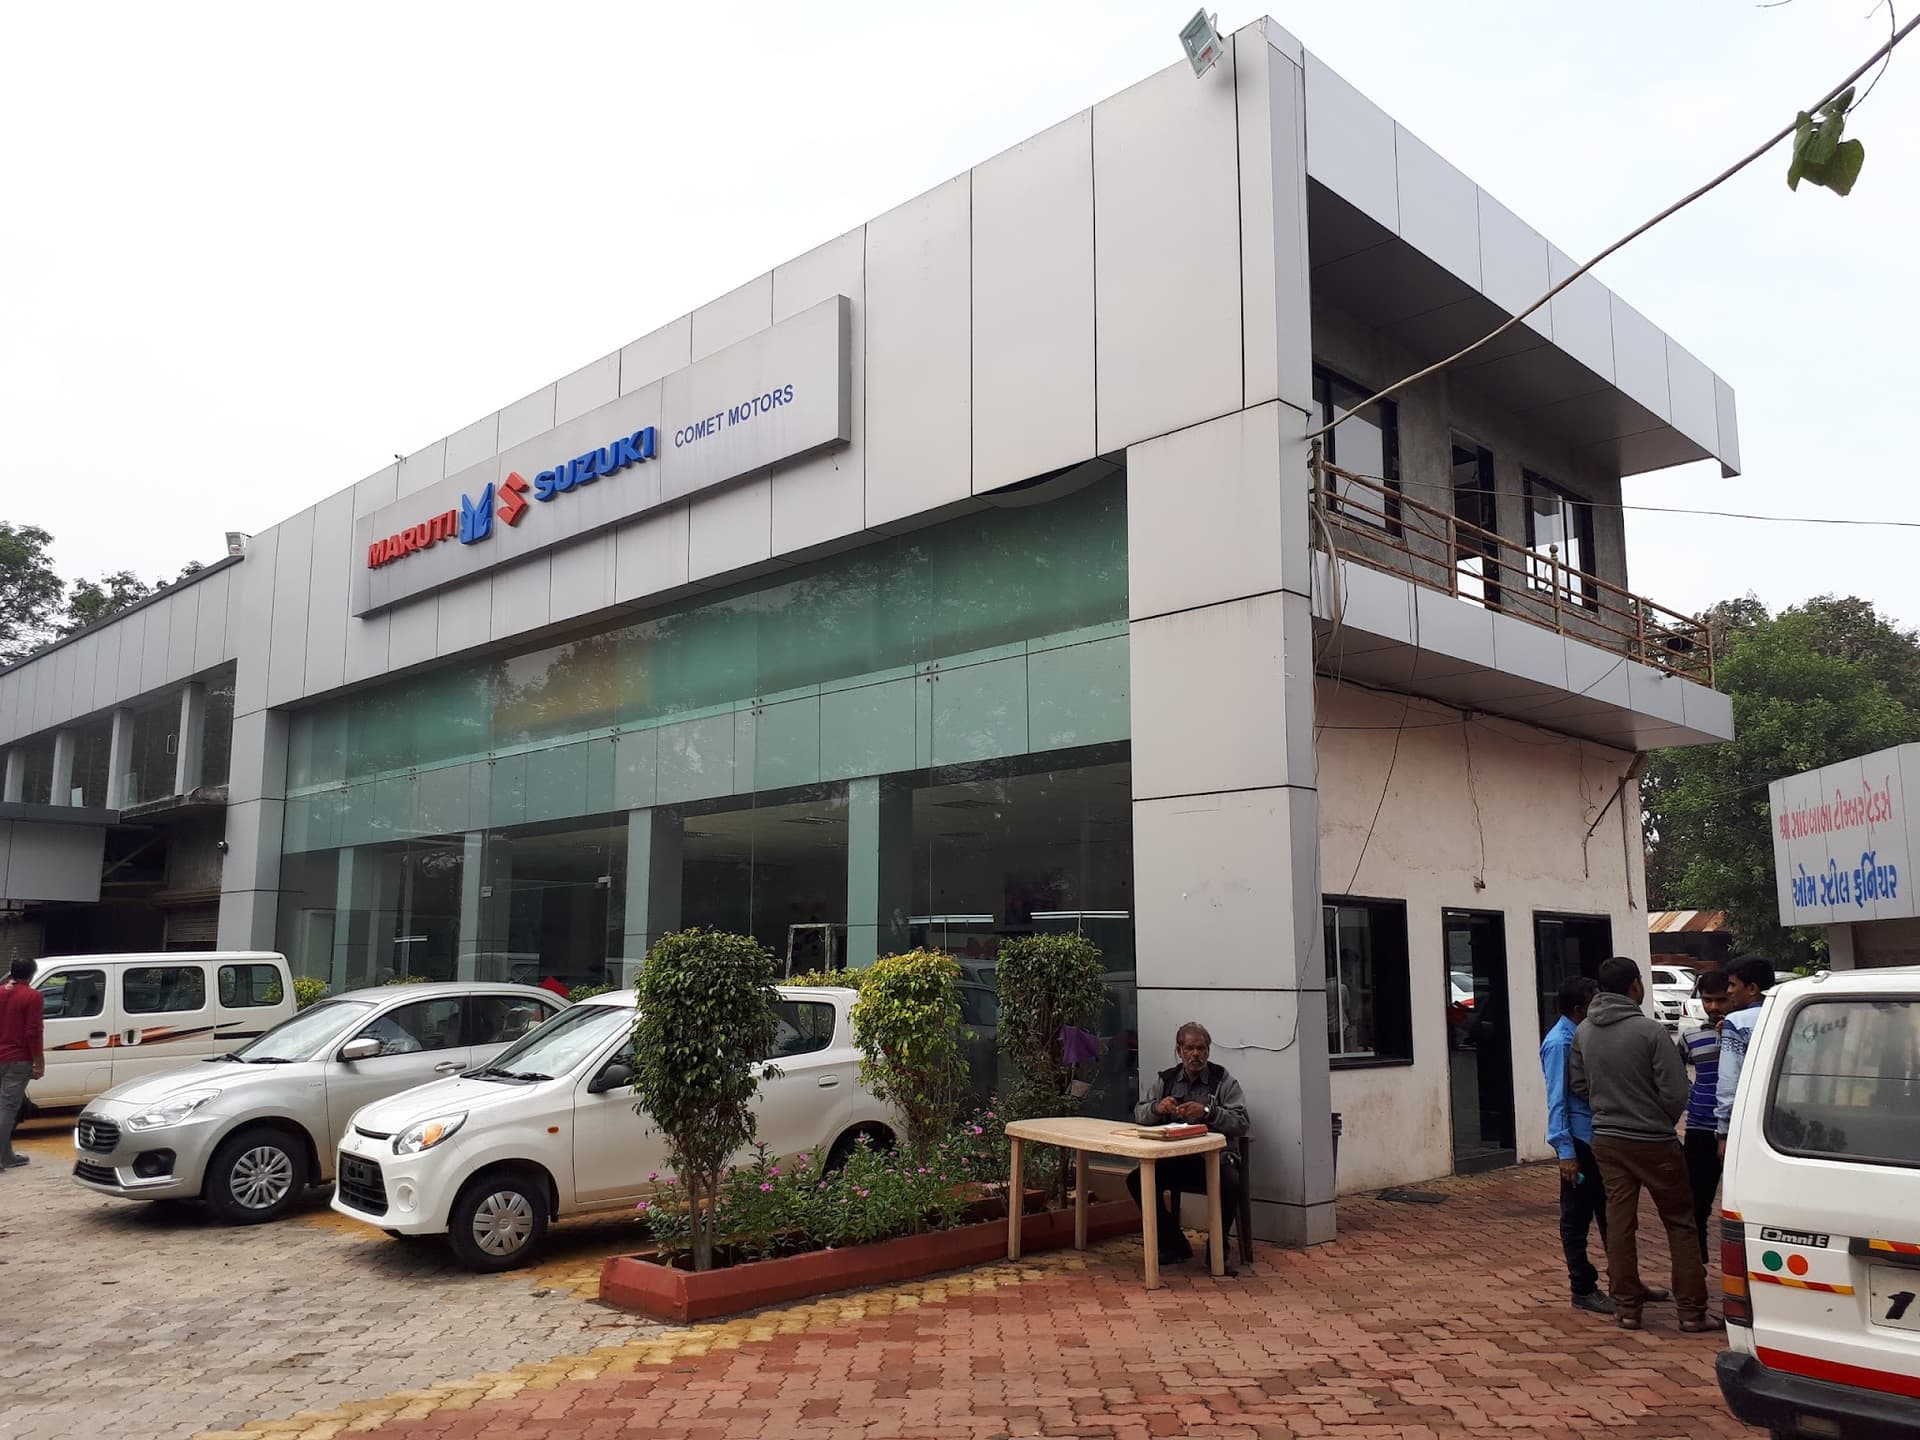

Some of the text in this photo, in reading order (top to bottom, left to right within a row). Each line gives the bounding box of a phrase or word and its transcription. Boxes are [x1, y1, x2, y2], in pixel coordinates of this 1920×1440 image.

[675, 384, 793, 448] COMET MOTORS
[368, 509, 457, 568] MARUTI
[534, 426, 657, 501] SUZUKI
[1762, 1229, 1828, 1247] Omni E
